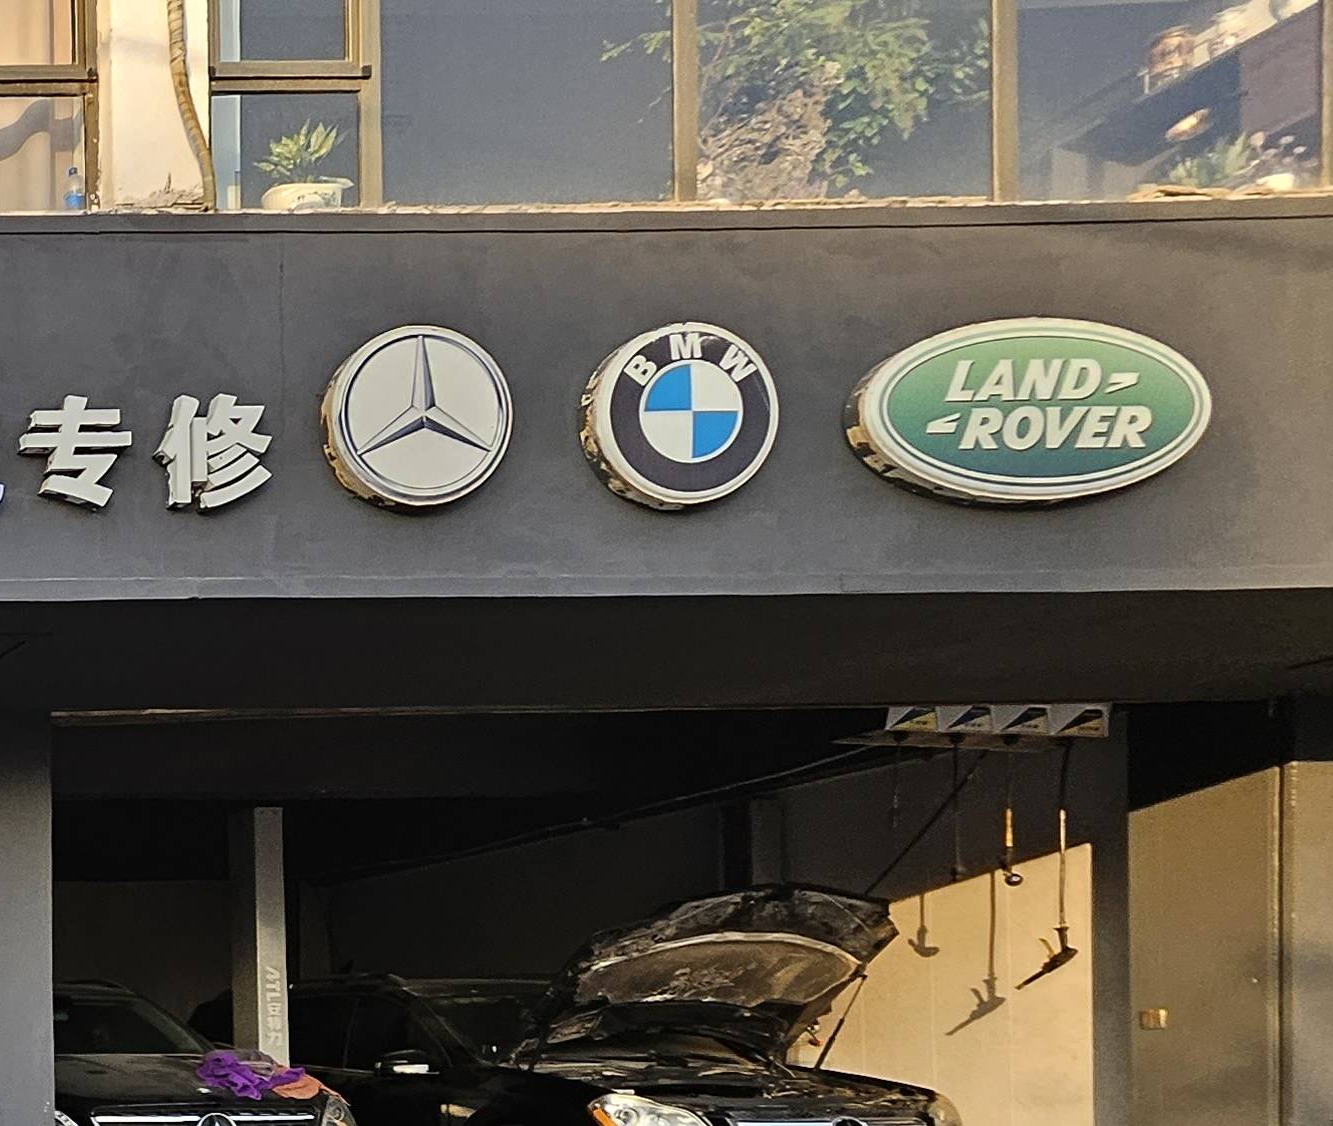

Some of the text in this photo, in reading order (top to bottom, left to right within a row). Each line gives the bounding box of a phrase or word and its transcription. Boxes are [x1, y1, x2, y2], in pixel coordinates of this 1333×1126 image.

[623, 333, 758, 387] BMW
[944, 358, 1103, 402] LAND
[958, 405, 1153, 452] ROVER
